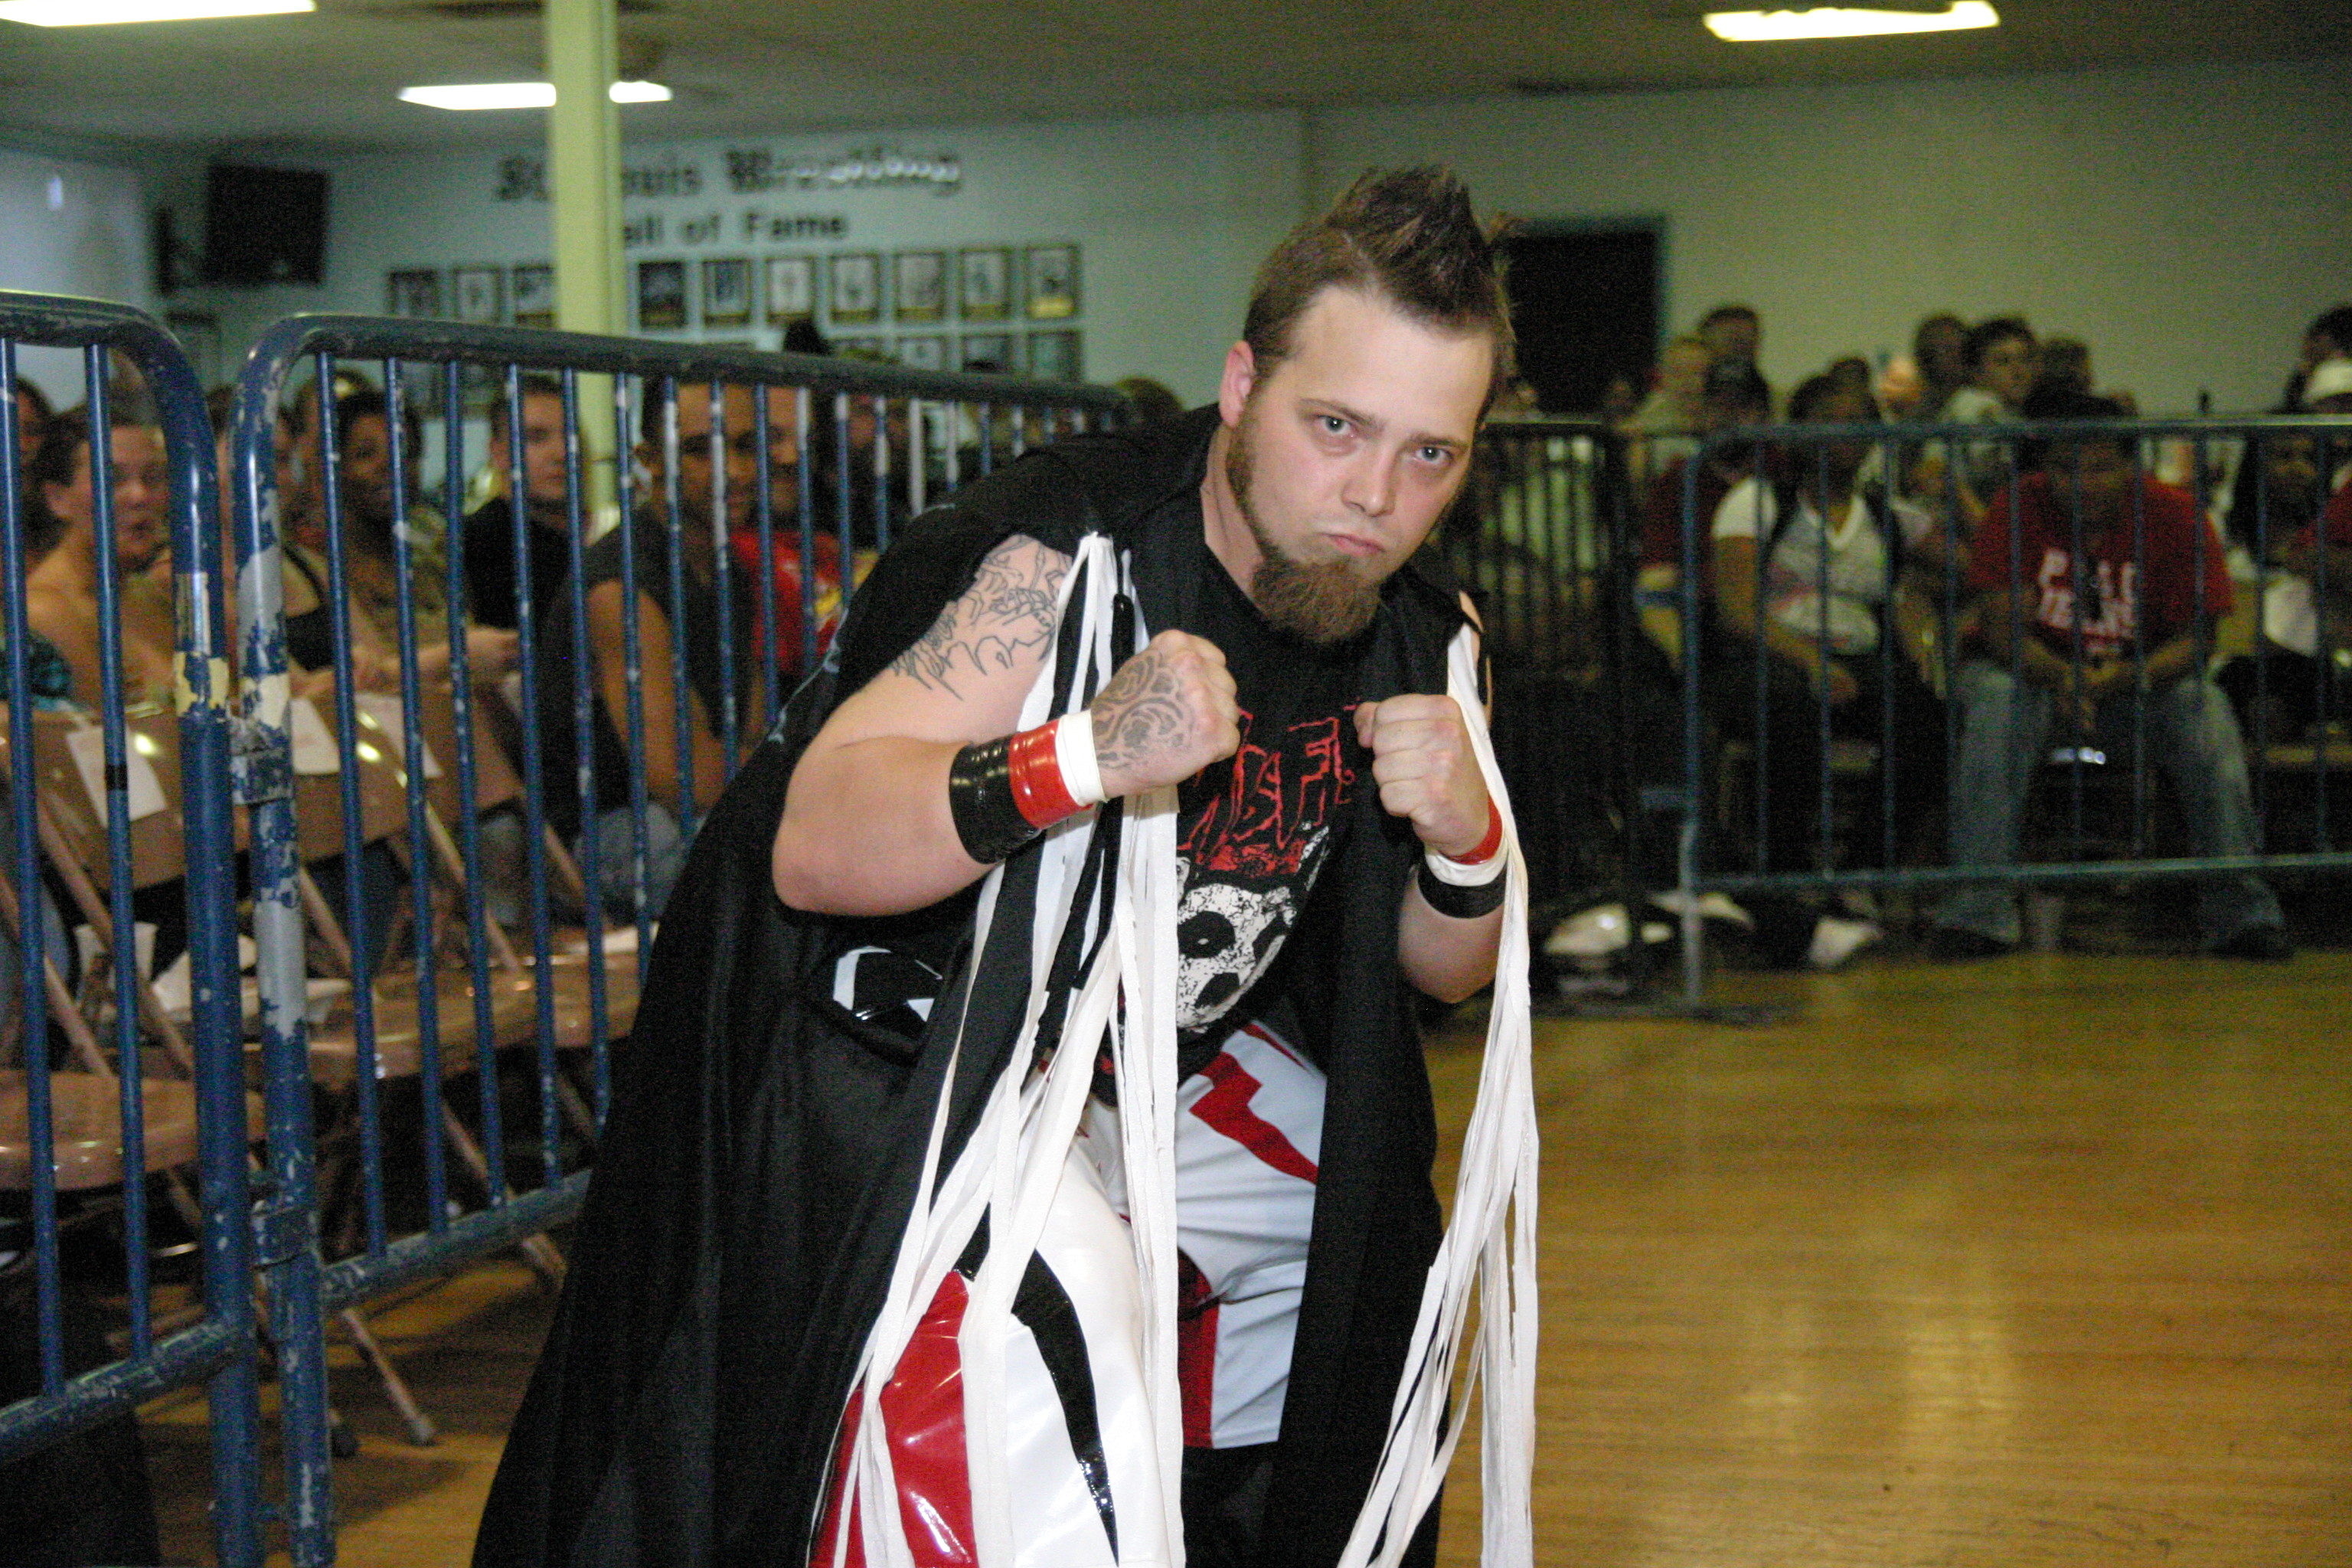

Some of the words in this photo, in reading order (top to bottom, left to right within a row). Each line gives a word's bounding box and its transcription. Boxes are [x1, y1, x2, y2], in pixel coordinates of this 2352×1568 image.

[621, 214, 665, 247] all
[678, 213, 723, 246] of
[742, 208, 848, 243] Fame
